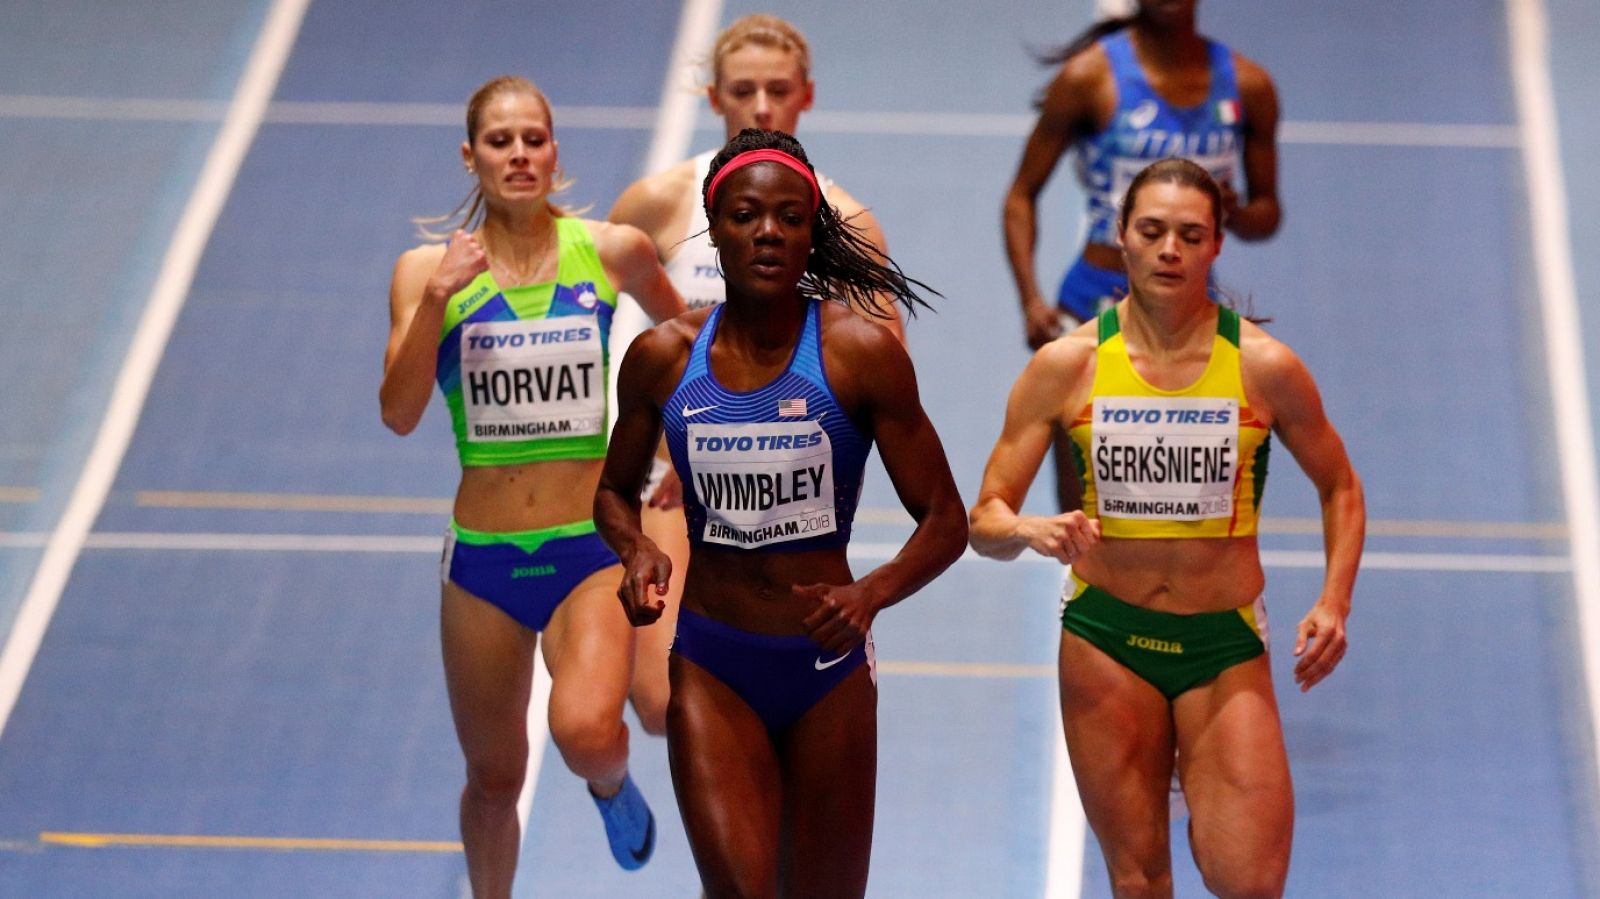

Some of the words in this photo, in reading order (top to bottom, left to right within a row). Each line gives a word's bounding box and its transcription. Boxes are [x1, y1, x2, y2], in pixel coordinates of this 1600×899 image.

[468, 334, 525, 350] TOYO
[529, 327, 592, 345] TIRES
[469, 362, 594, 406] HORVAT
[1102, 409, 1162, 424] TOYO
[1165, 410, 1231, 424] TIRES
[475, 420, 572, 437] BIRMINGHAM
[695, 436, 753, 452] TOYO
[757, 431, 823, 450] TIRES
[697, 464, 825, 511] WIMBLEY
[1104, 499, 1200, 515] BIRMINGHAM
[709, 521, 799, 544] BIRMINGHAM
[800, 514, 830, 534] 2018
[1126, 634, 1184, 654] Joma
